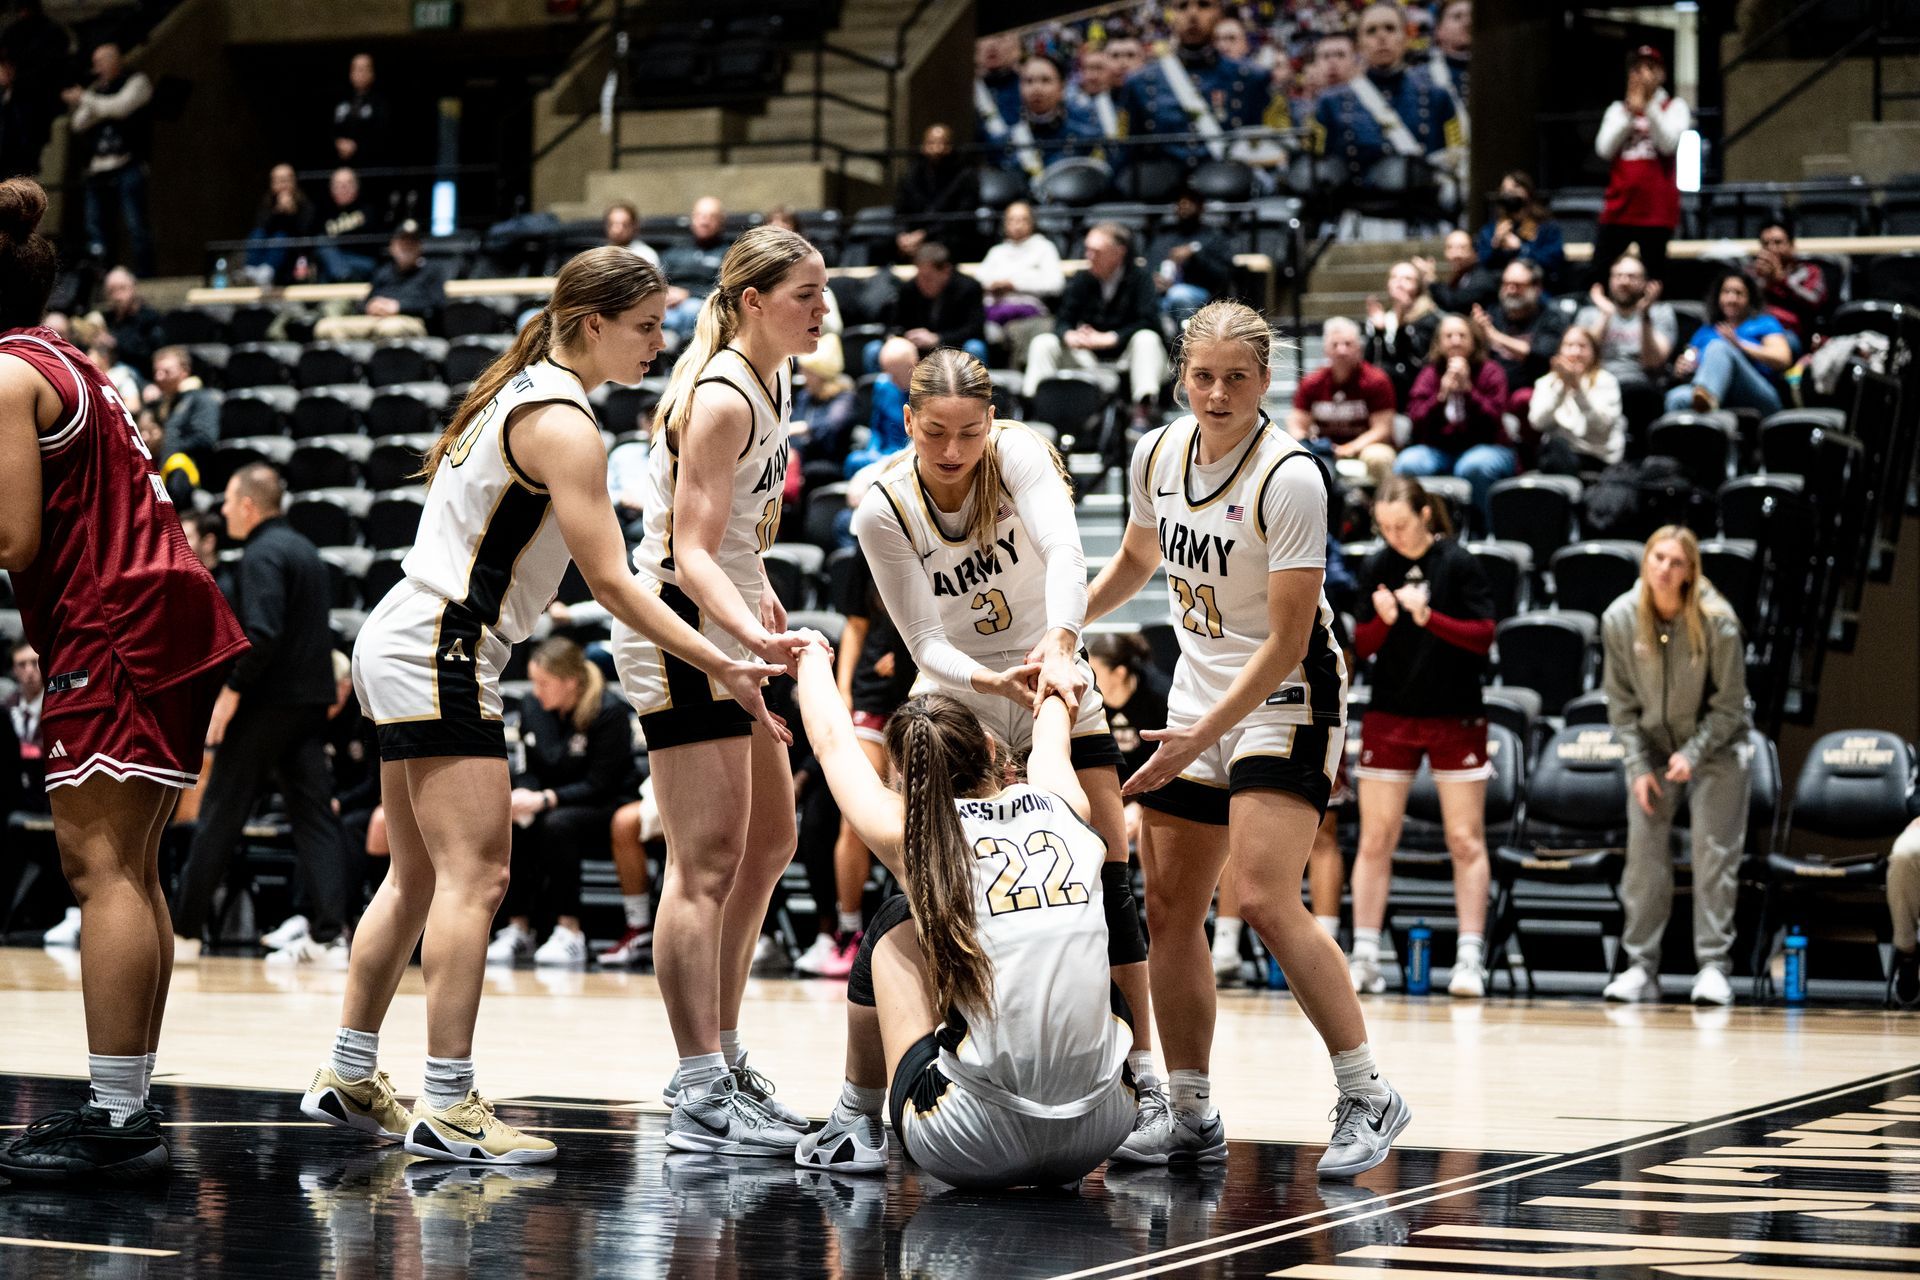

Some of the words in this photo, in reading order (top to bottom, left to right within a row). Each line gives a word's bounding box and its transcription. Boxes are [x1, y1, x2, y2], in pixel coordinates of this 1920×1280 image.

[445, 397, 498, 468] 0
[751, 435, 791, 493] ARM
[933, 527, 1019, 597] ARMY
[1159, 516, 1236, 577] ARMY
[970, 587, 1013, 636] 3
[1168, 573, 1225, 639] 21
[444, 637, 470, 661] A
[1012, 793, 1054, 818] POINT
[974, 830, 1089, 916] 22
